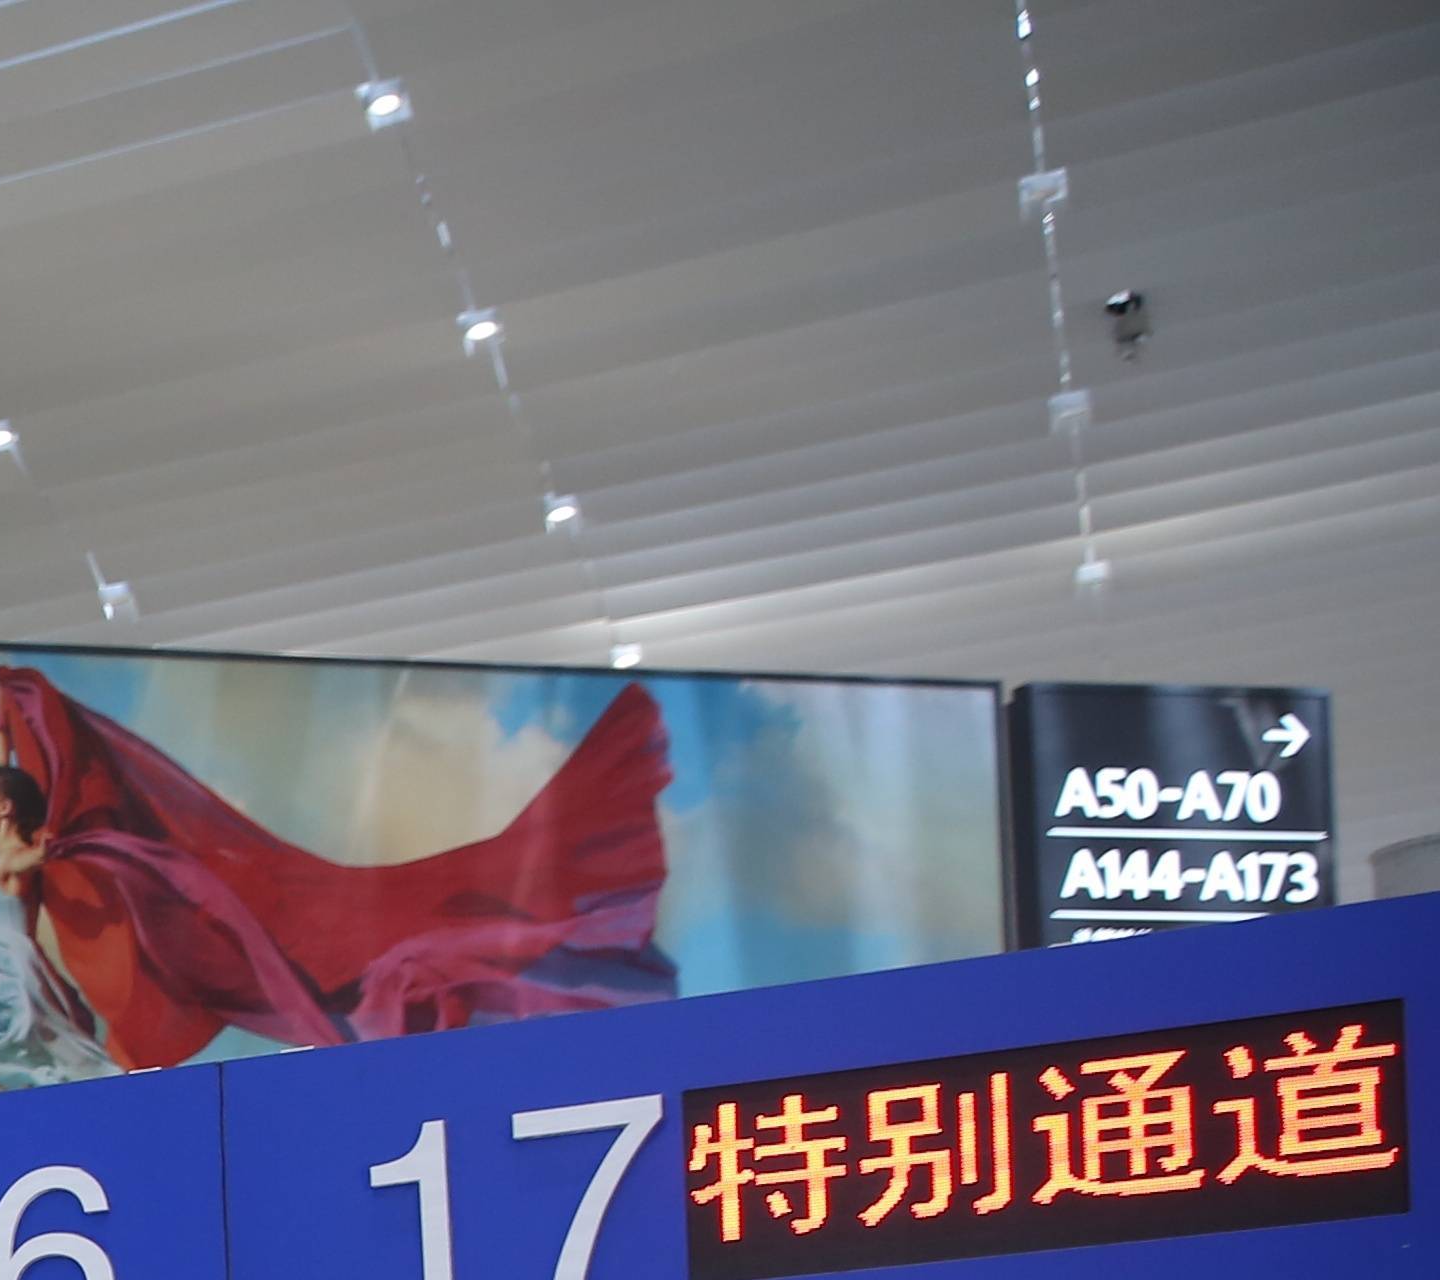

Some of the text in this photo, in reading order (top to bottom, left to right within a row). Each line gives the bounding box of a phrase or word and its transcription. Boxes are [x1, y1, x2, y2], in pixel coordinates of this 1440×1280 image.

[1054, 767, 1280, 823] A50-A70
[1059, 848, 1320, 903] A144-A173
[686, 1023, 1400, 1244] 特别通道
